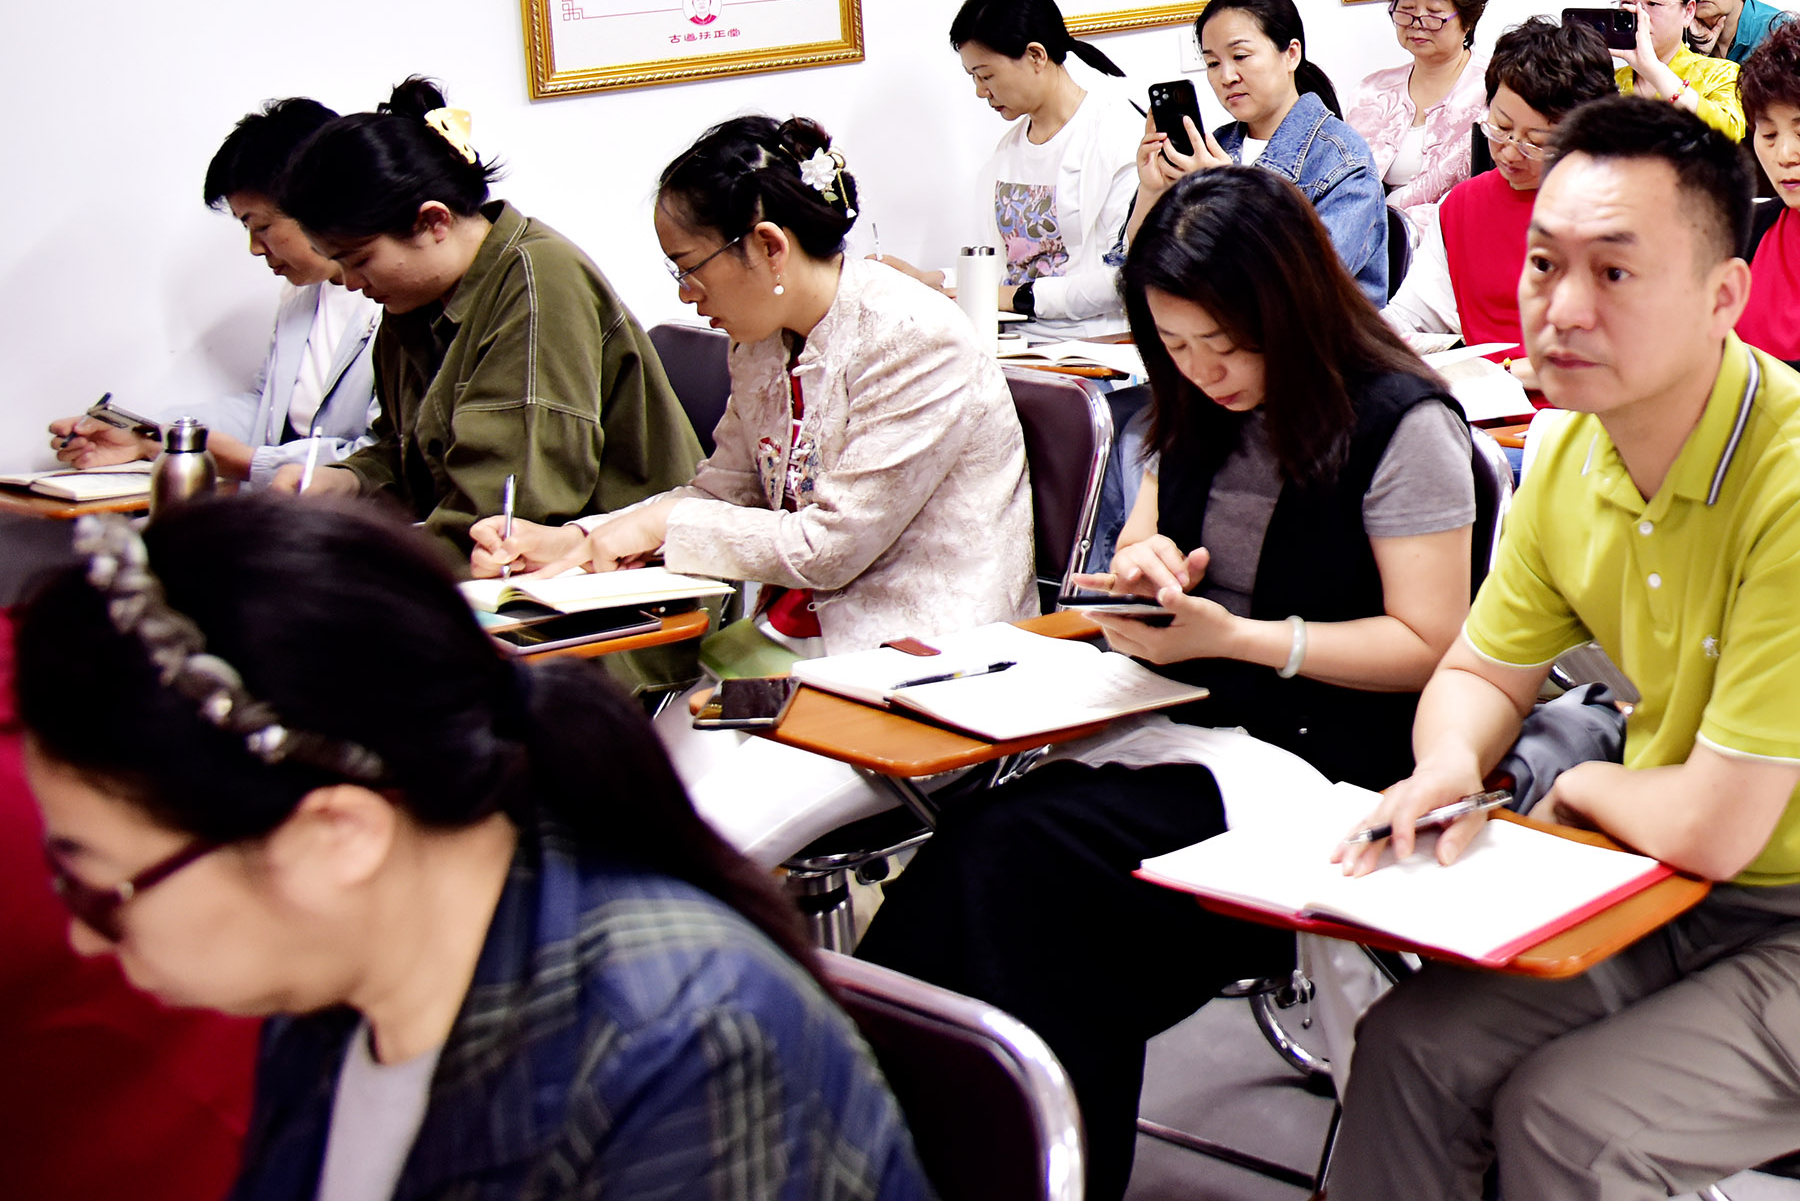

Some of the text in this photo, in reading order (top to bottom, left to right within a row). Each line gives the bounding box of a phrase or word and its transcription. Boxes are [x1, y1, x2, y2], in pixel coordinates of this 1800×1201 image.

[669, 28, 740, 43] 古道扶正堂
